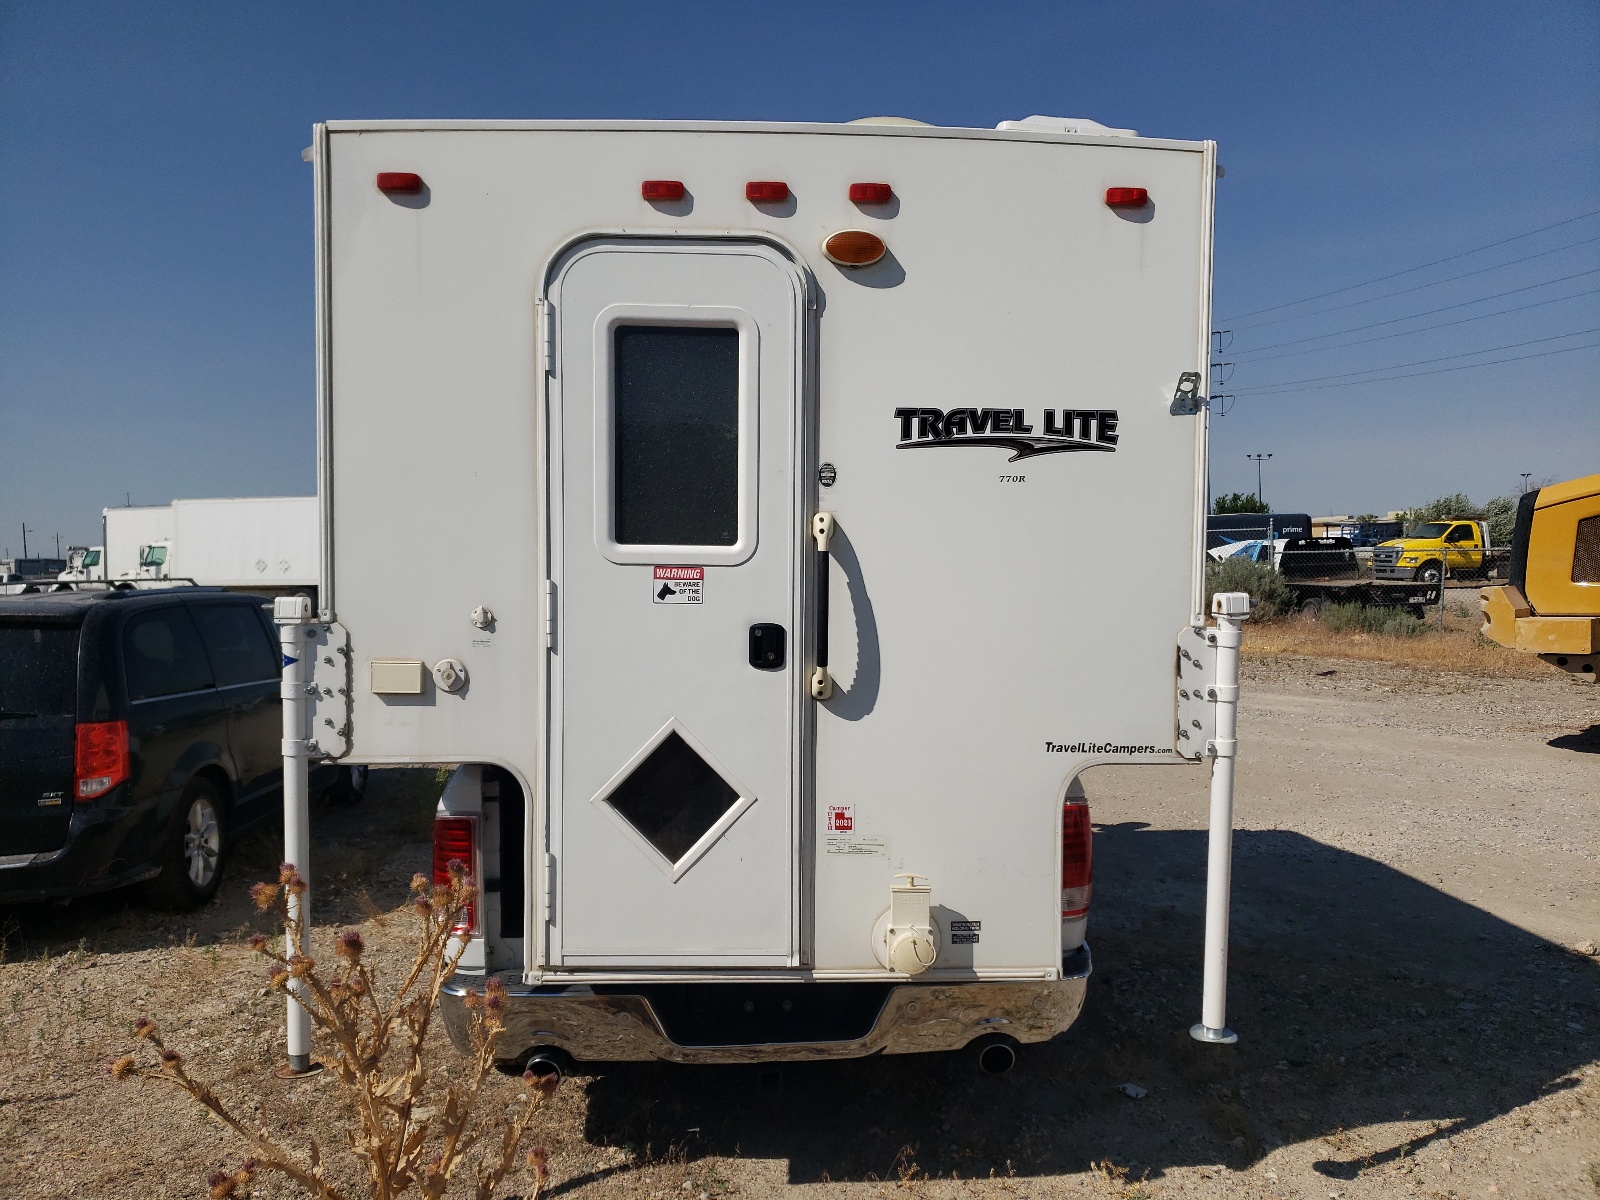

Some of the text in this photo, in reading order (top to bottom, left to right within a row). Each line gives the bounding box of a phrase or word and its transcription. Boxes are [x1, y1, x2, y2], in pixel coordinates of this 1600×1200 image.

[894, 407, 1119, 445] TRAVEL LITE
[998, 475, 1026, 483] 770R
[1282, 525, 1303, 535] prime
[656, 568, 701, 579] WARNING
[1045, 741, 1173, 756] TravelLiteCampers.com
[828, 805, 851, 813] Camper
[835, 818, 852, 827] 2023
